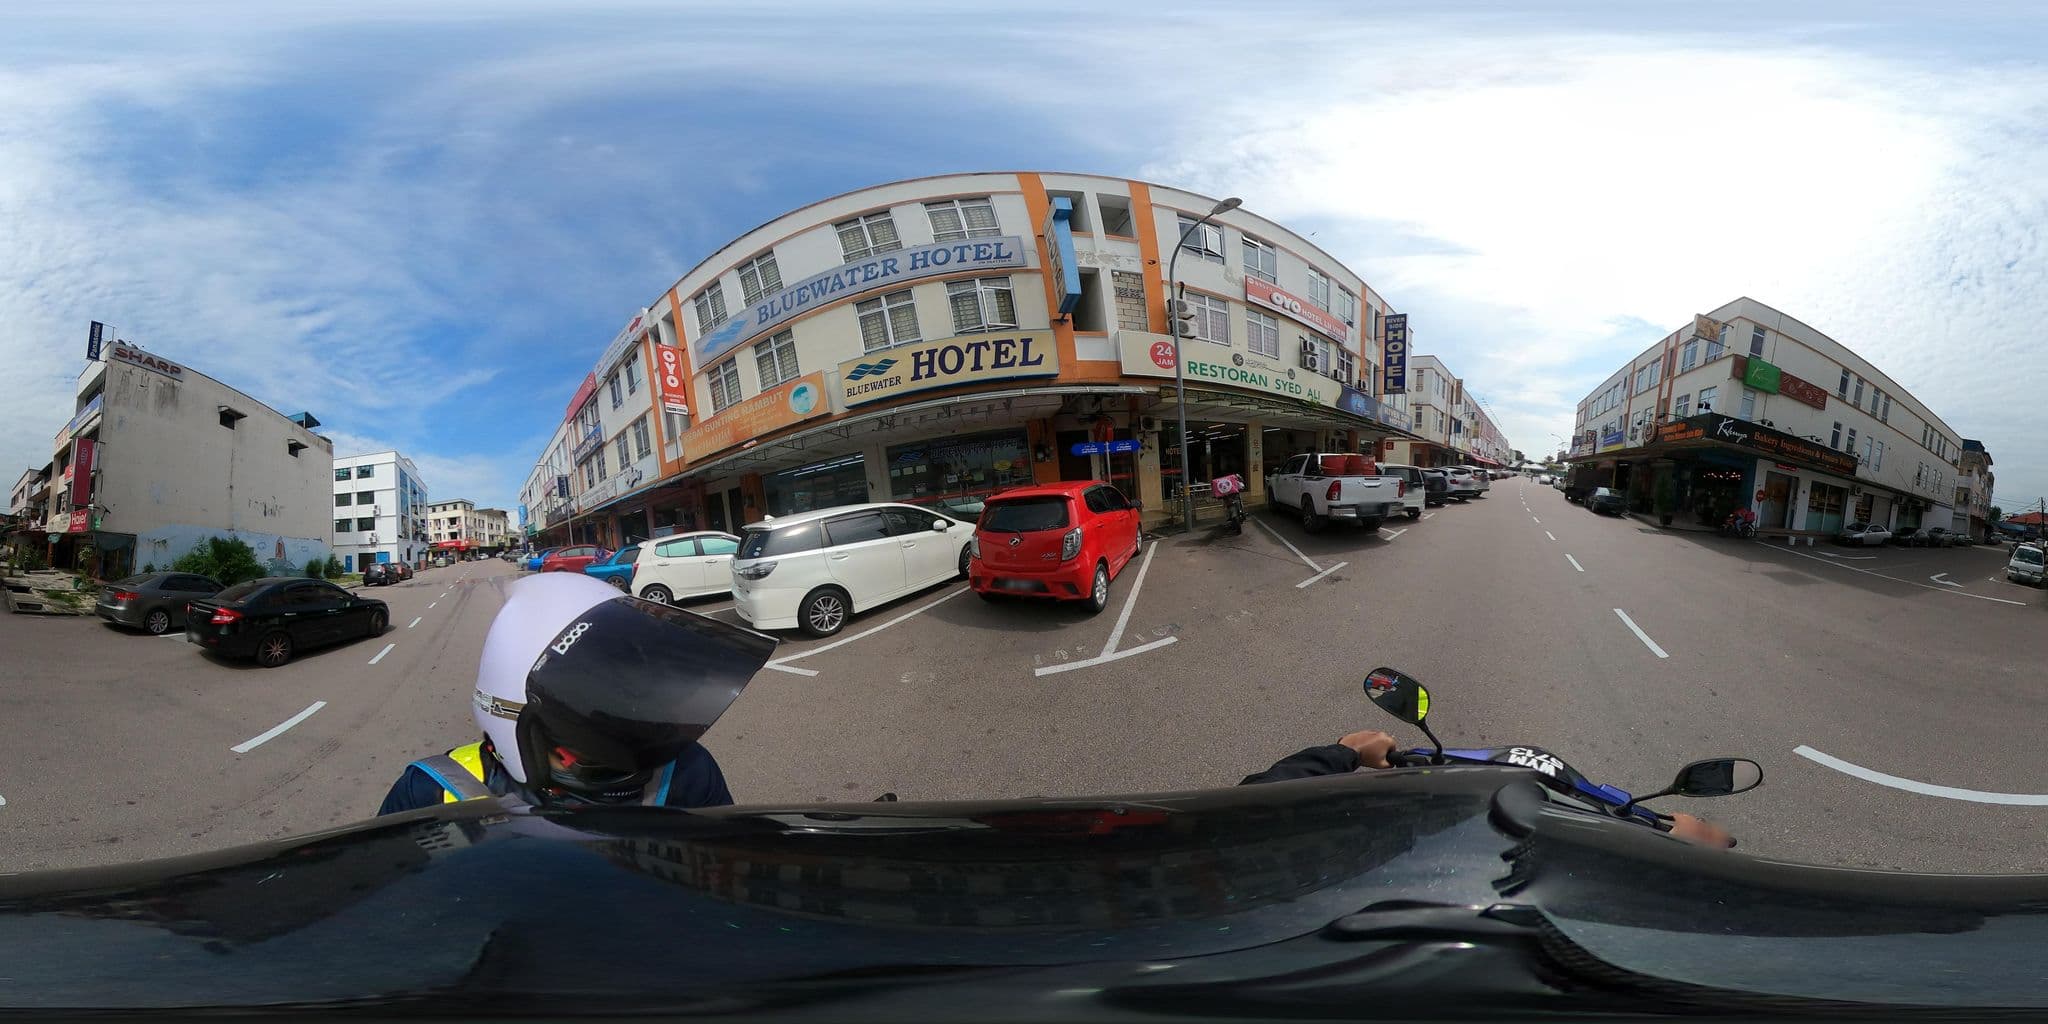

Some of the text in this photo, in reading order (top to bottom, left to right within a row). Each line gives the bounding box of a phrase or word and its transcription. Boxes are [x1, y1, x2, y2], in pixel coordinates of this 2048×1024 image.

[757, 242, 1013, 325] BLUEWATER HOTEL
[1270, 292, 1301, 313] OYO
[1302, 308, 1323, 326] HOTEL
[89, 323, 101, 358] Panasonic
[1156, 344, 1174, 357] 24
[114, 347, 182, 374] SHARP
[662, 350, 679, 388] OYO
[910, 337, 1044, 382] HOTEL
[1156, 357, 1175, 367] JAM
[1387, 329, 1405, 389] HOTEL
[846, 375, 902, 398] BLUEWATER
[1187, 360, 1268, 388] RESTORAN
[1275, 378, 1302, 396] SYED
[1307, 388, 1321, 401] ALI
[704, 410, 741, 435] GUNTING
[741, 391, 784, 418] RAMBUT
[1754, 431, 1779, 449] Bakery
[71, 512, 87, 526] Haier
